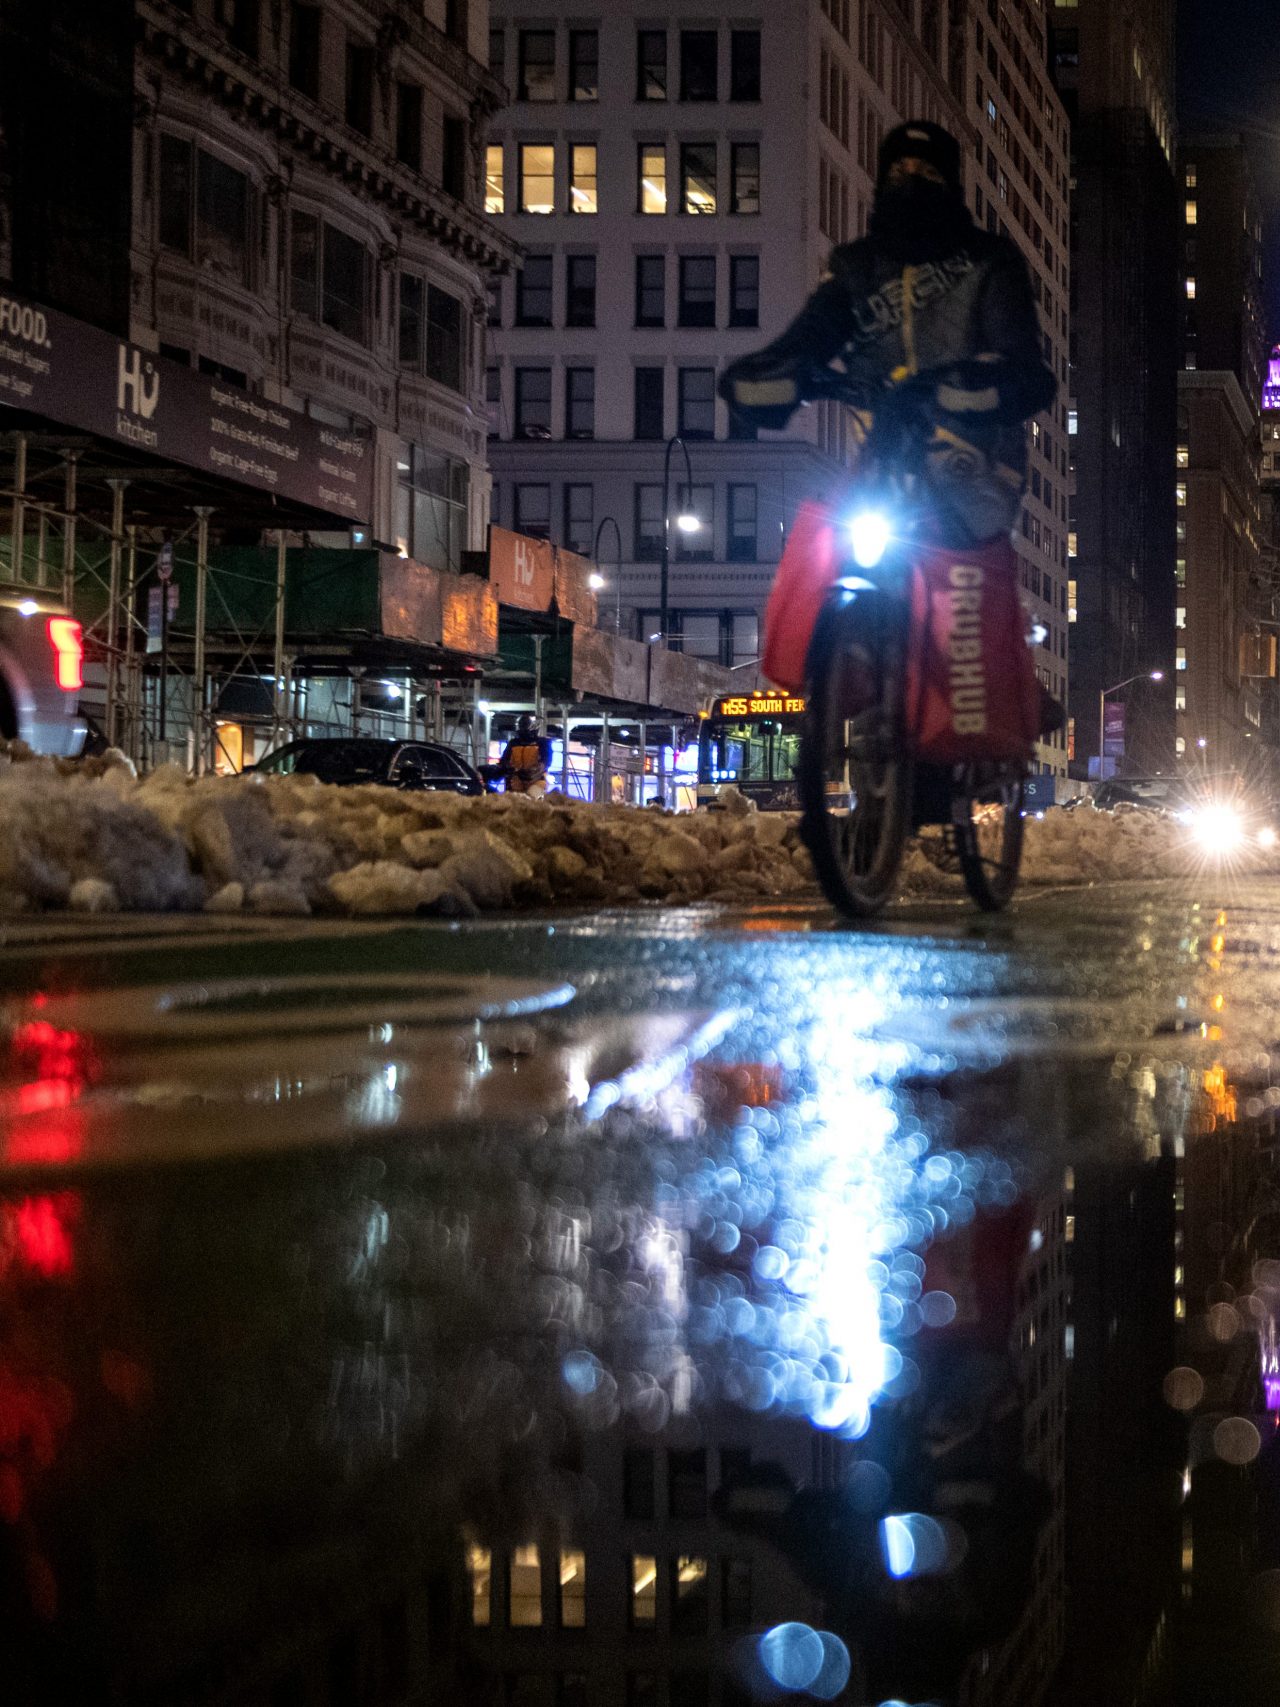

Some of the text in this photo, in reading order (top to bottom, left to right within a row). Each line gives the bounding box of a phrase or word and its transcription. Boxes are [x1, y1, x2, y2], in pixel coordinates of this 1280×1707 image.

[0, 297, 52, 349] FOOD.
[117, 412, 157, 448] kitchen
[950, 565, 986, 735] GRUBHUB
[721, 697, 748, 716] M55
[749, 698, 783, 713] SOUTH
